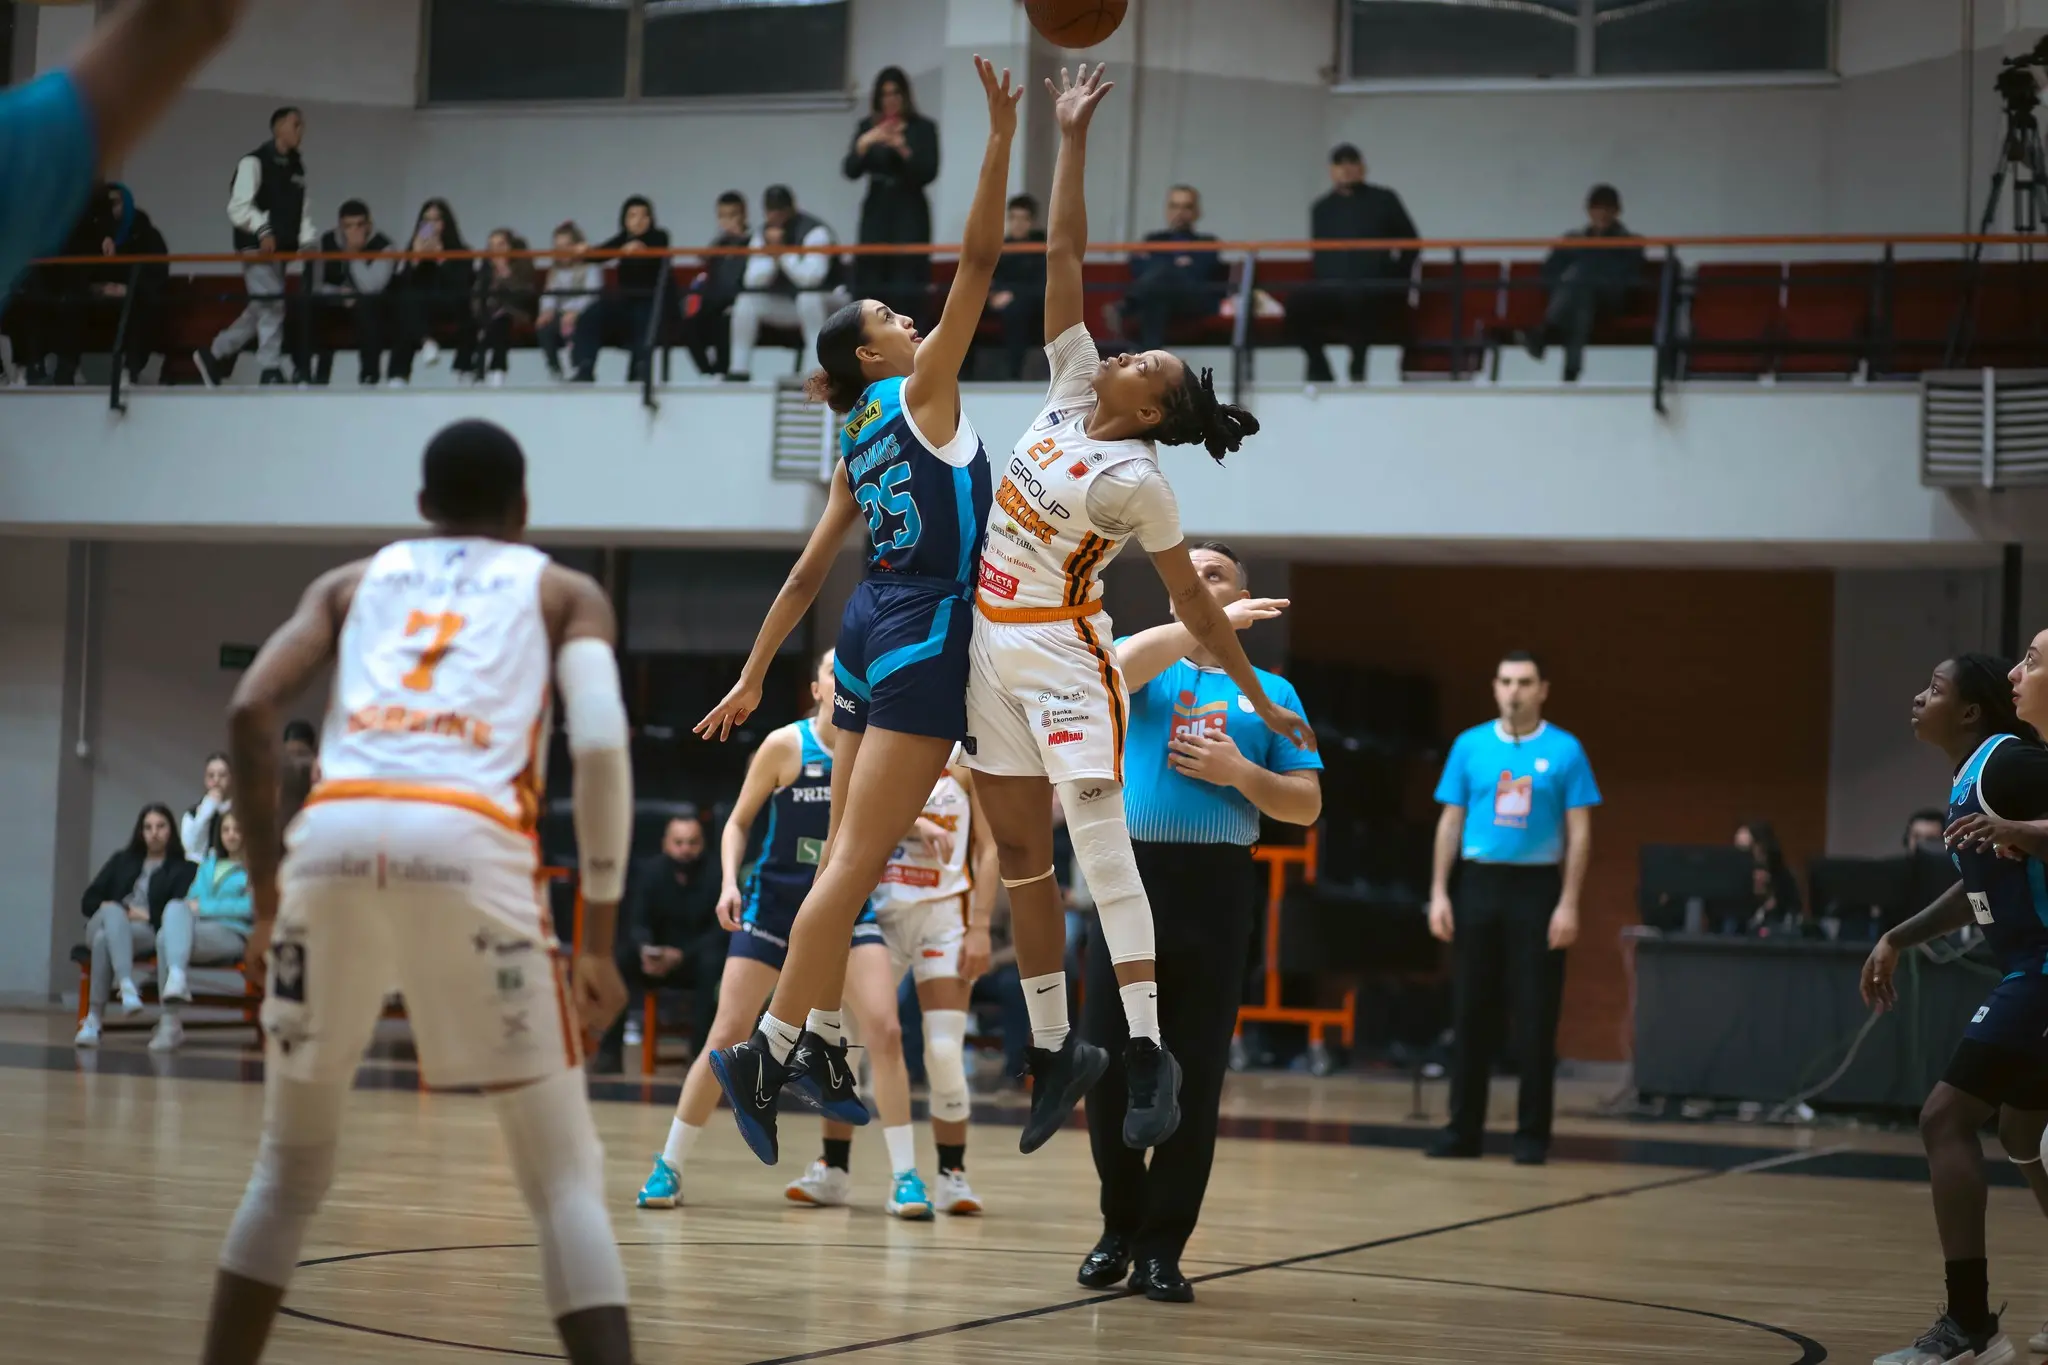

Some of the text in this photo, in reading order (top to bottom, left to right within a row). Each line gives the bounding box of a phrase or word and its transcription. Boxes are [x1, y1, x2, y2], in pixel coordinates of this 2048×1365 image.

[849, 433, 900, 485] WILLIAMS
[1027, 438, 1064, 470] 21
[855, 461, 922, 560] 25
[1010, 457, 1071, 520] GROUP
[1013, 557, 1036, 573] Holding
[402, 609, 466, 692] 7
[1052, 715, 1089, 724] Ekonomike
